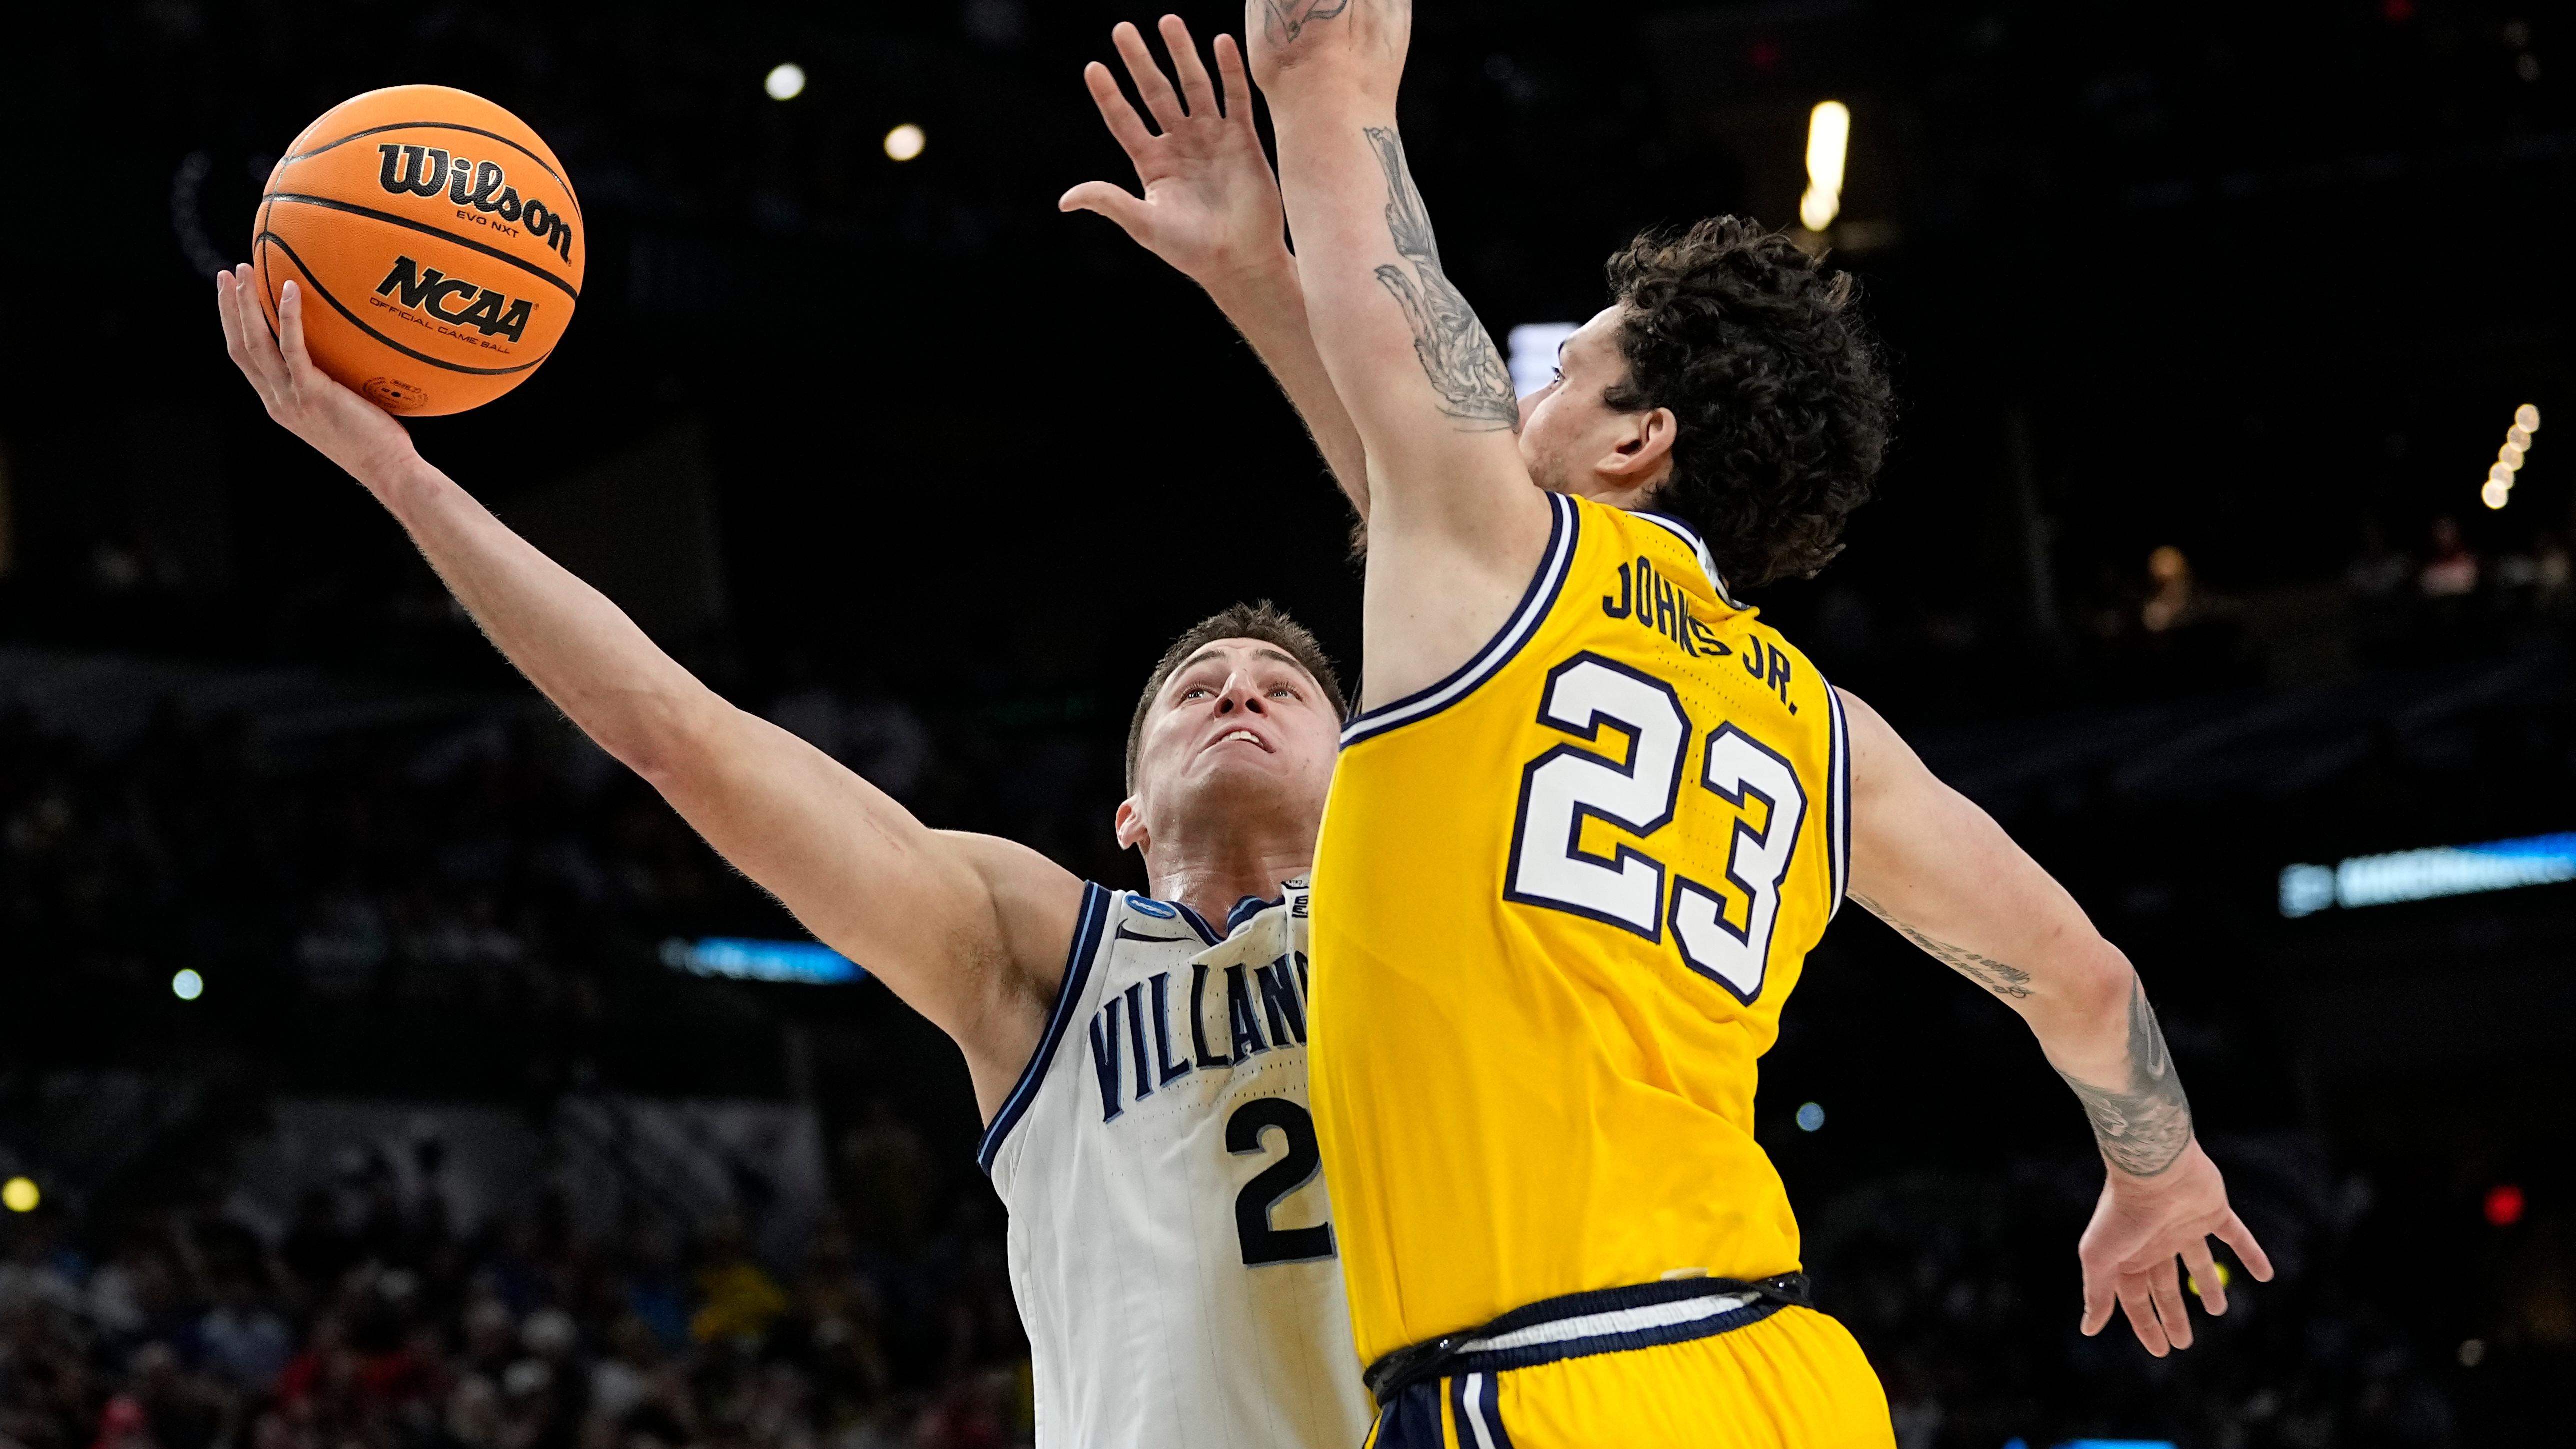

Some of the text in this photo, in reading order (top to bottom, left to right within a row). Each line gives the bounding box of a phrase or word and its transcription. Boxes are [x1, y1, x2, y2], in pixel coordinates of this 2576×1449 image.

[377, 142, 572, 264] Wilson
[457, 210, 518, 238] EVO NXT
[369, 297, 510, 354] OFFICIAL GAME BALL
[375, 255, 533, 344] NCAA
[1743, 634, 1798, 716] JR.
[1503, 650, 1806, 1007] 23
[1225, 1098, 1338, 1268] 2
